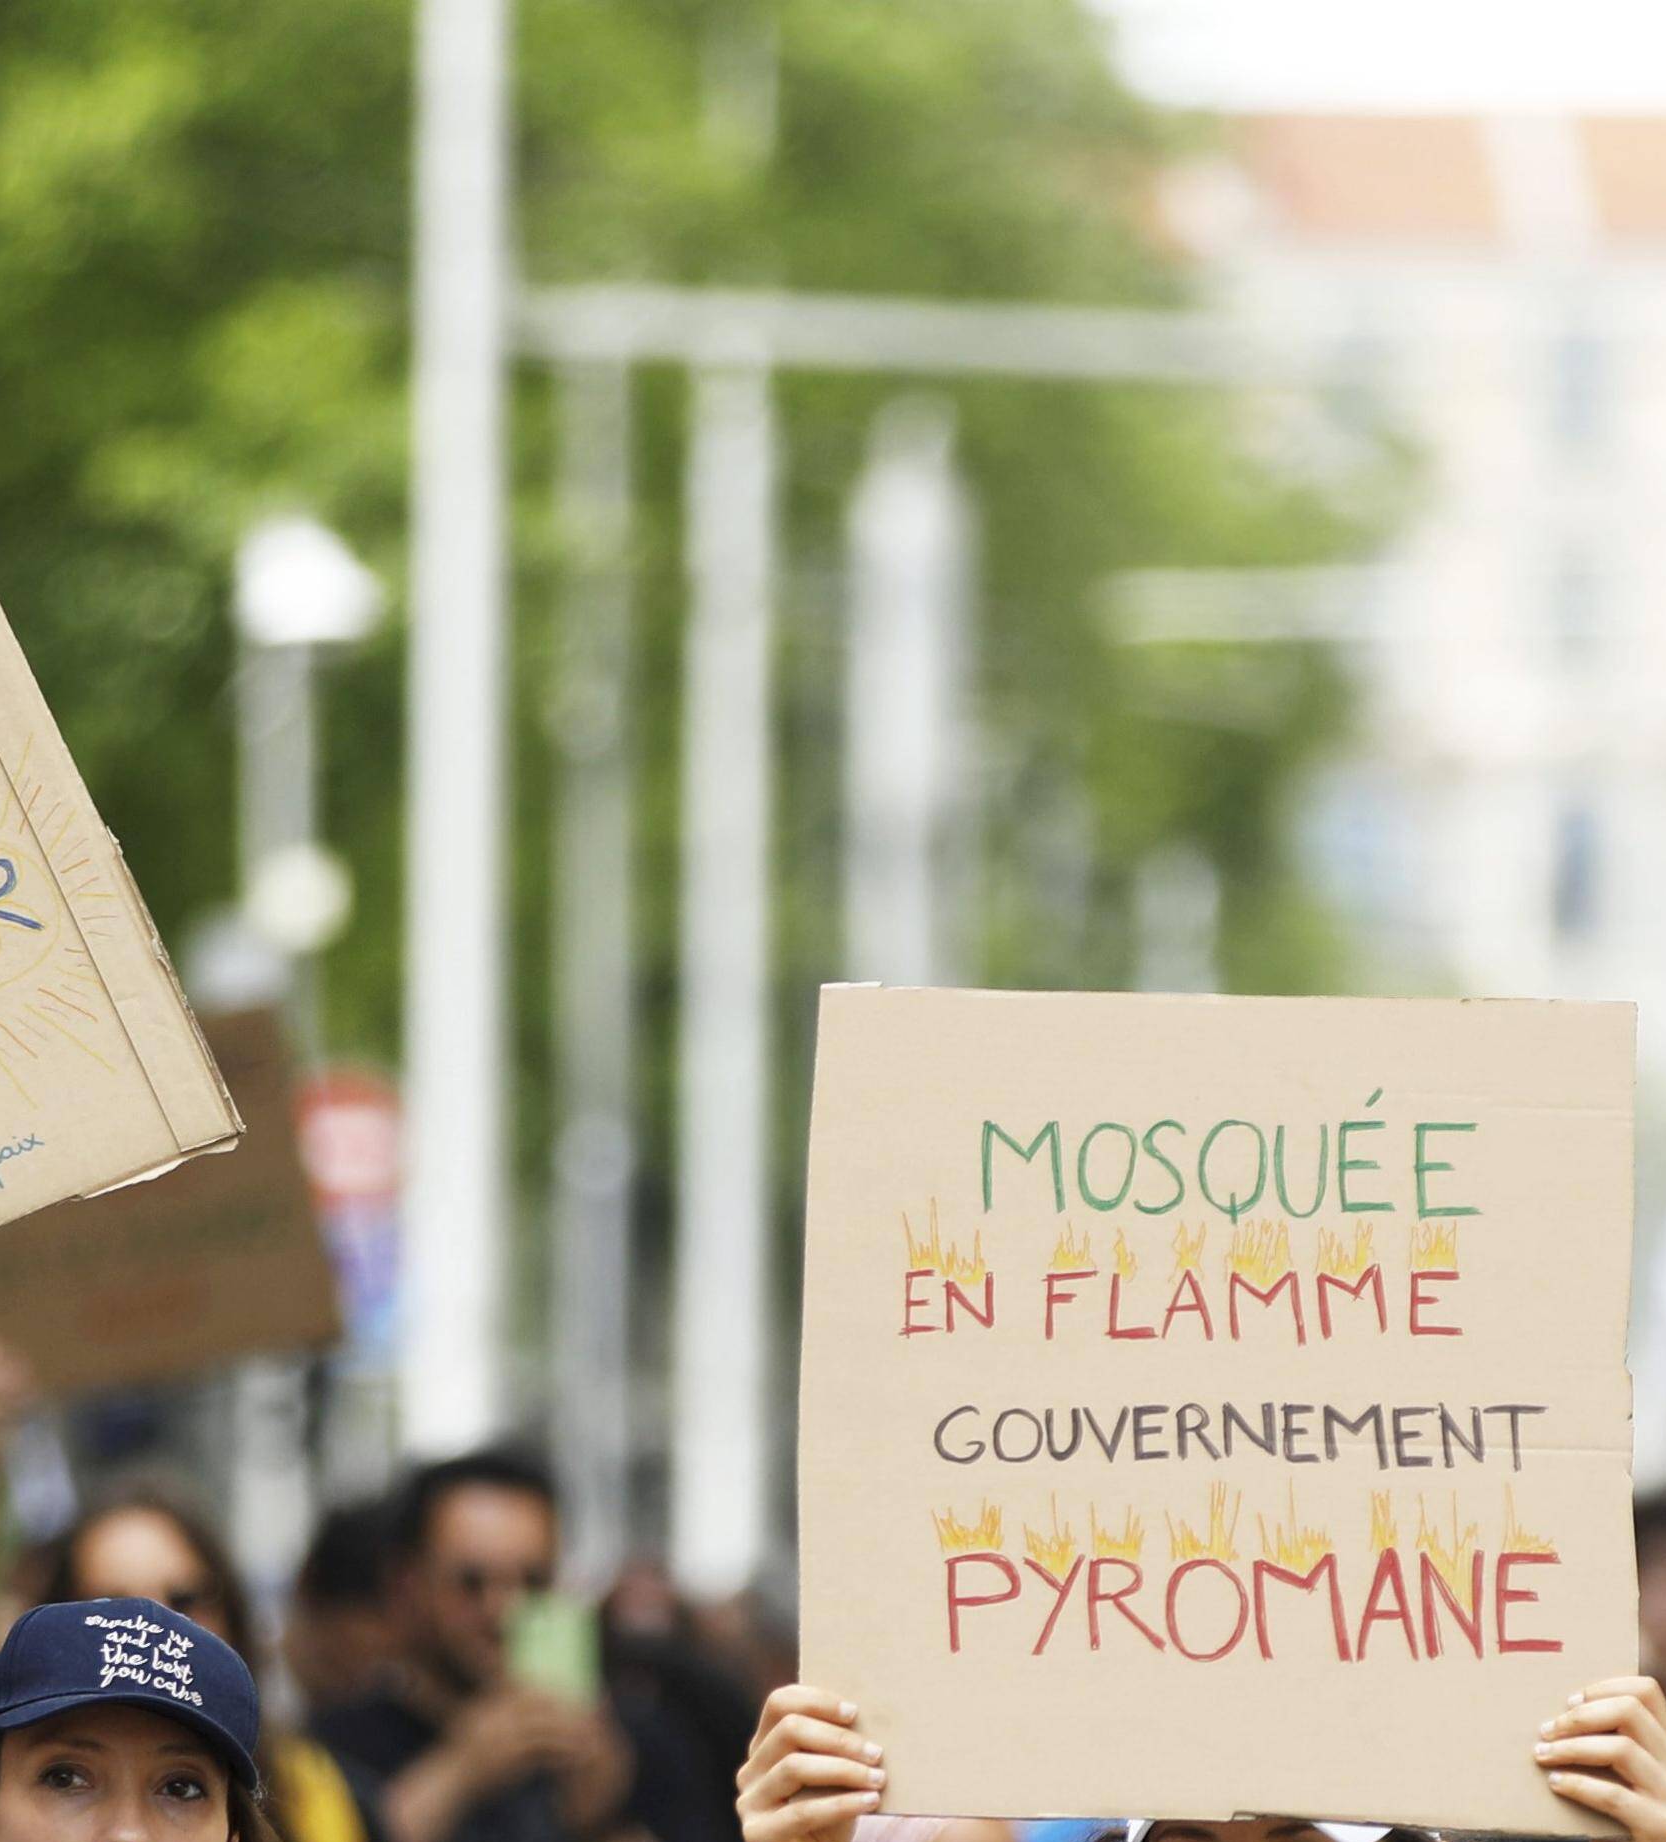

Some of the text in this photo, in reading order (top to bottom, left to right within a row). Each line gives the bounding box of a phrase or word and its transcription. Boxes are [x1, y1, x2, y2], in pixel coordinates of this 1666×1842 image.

[978, 1087, 1482, 1226] MOSQUÉE
[898, 1267, 1464, 1347] EN FLAMME
[933, 1401, 1548, 1471] GOUVERNEMENT
[944, 1547, 1564, 1664] PYROMANE
[99, 1642, 194, 1685] the best
[105, 1630, 188, 1659] and do
[169, 1629, 195, 1653] up
[99, 1663, 152, 1689] you
